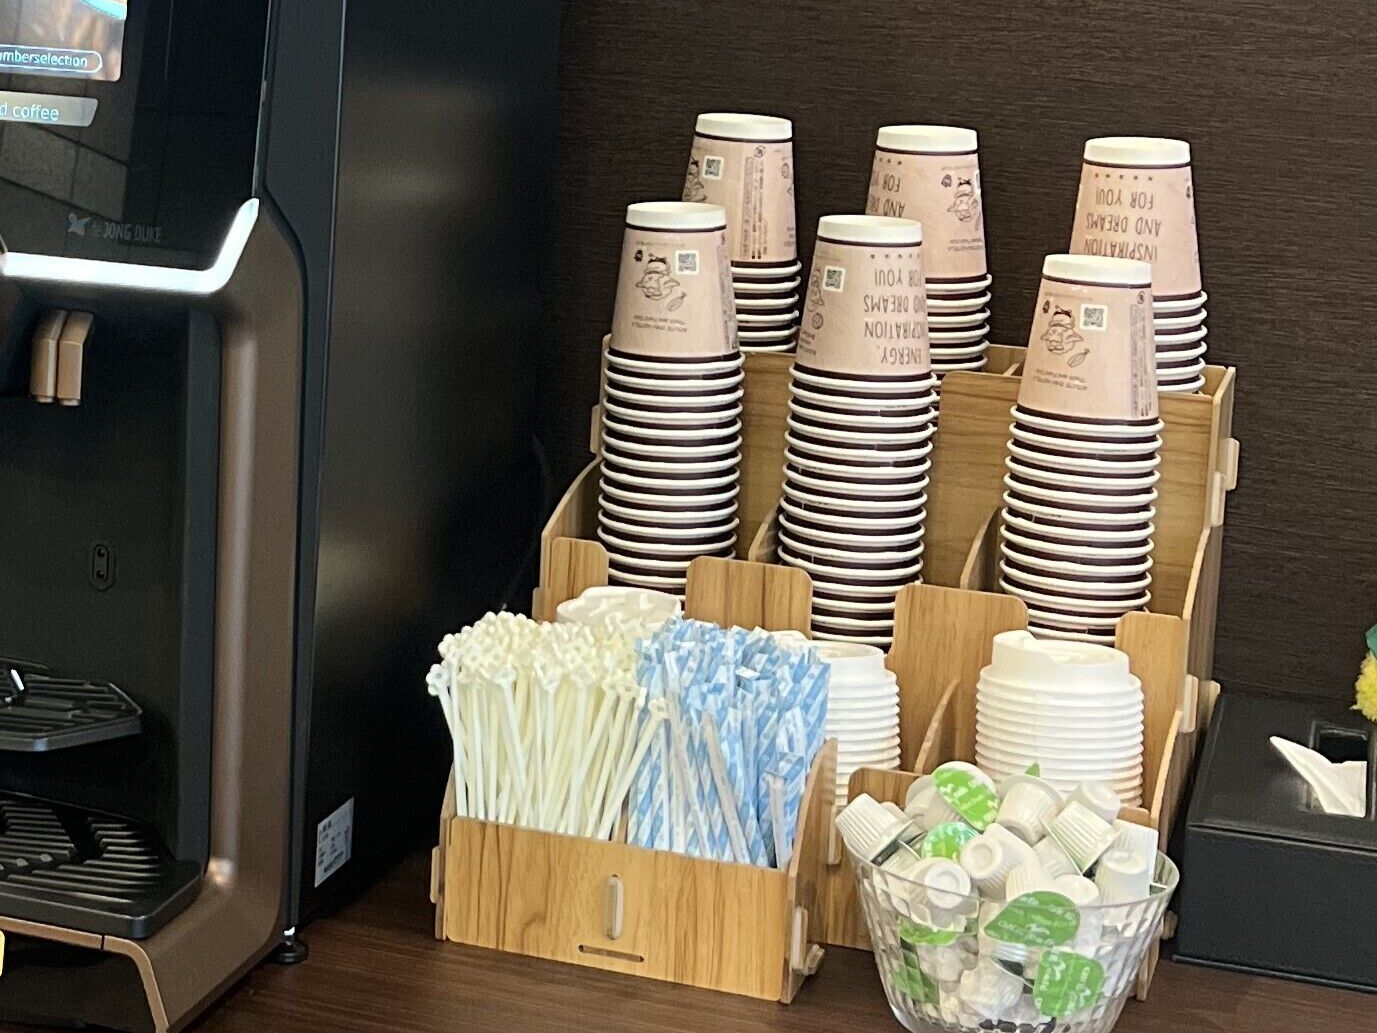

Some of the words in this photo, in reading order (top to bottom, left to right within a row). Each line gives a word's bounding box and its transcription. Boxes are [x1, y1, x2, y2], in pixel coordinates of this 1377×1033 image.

[12, 104, 60, 121] coffee
[882, 174, 901, 193] FOR
[1130, 191, 1154, 210] FOR
[103, 221, 132, 240] JONG
[134, 224, 162, 243] DUKE
[1086, 212, 1129, 233] DREAMS
[1135, 217, 1162, 237] AND
[1083, 238, 1158, 261] INSPIRATION
[863, 294, 909, 313] DREAMS
